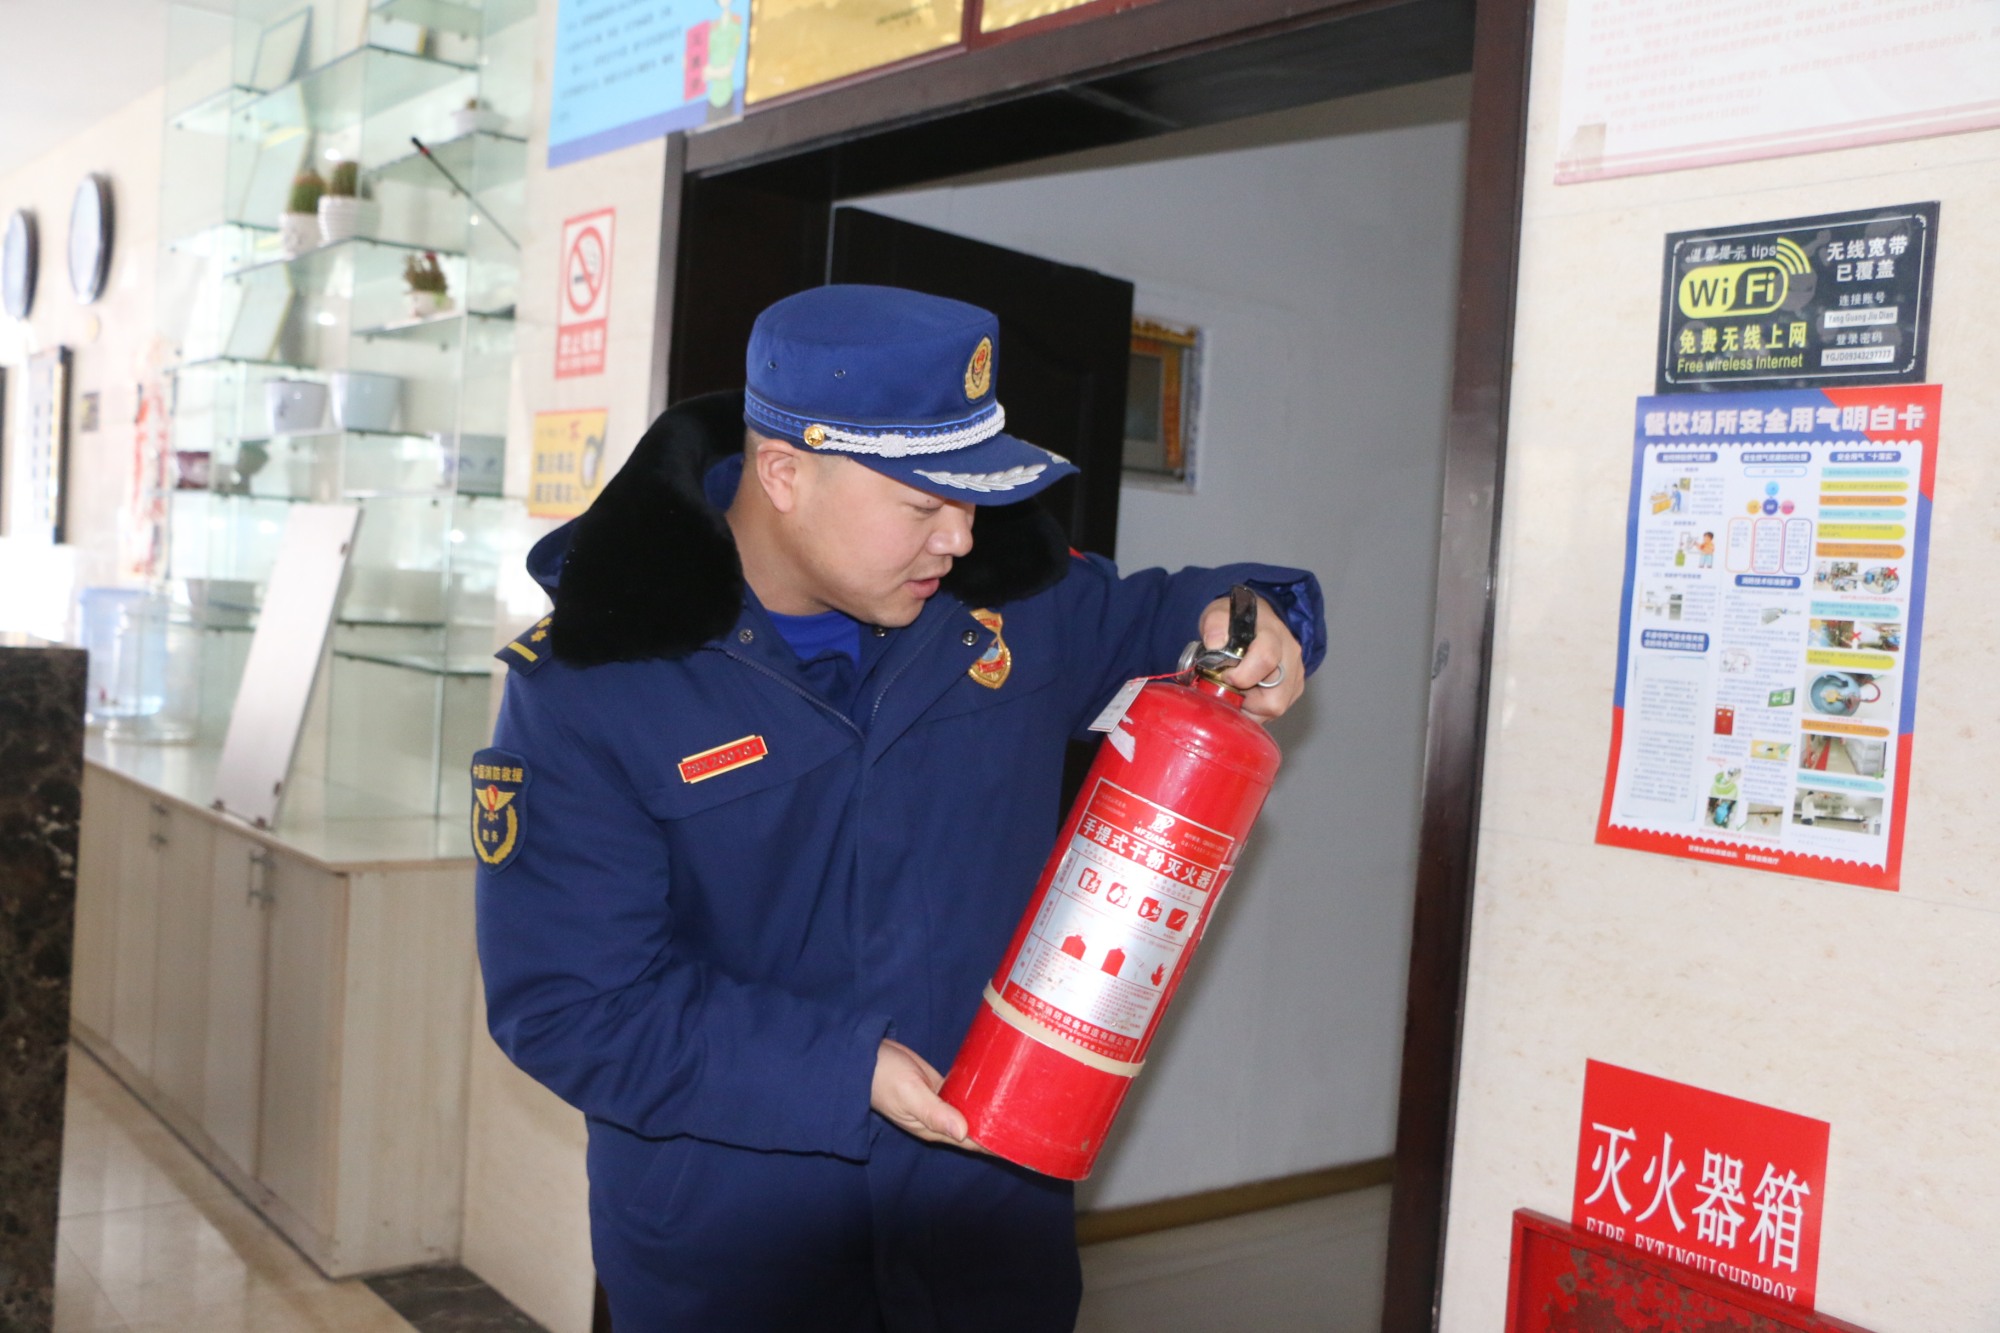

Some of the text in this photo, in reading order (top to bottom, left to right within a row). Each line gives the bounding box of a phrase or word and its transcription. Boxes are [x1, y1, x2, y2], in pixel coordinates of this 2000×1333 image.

[1751, 245, 1777, 259] tips
[1827, 235, 1908, 261] 无线宽带
[1836, 260, 1895, 282] 已覆盖
[1679, 322, 1807, 354] 免费无线上网
[1677, 353, 1803, 373] Free wireless Internet
[1644, 404, 1925, 437] 餐饮场所安全用气明白卡
[473, 764, 523, 783] 中国消防救援
[1083, 817, 1213, 888] 手提式干粉灭火器
[1583, 1121, 1811, 1273] 灭火器箱
